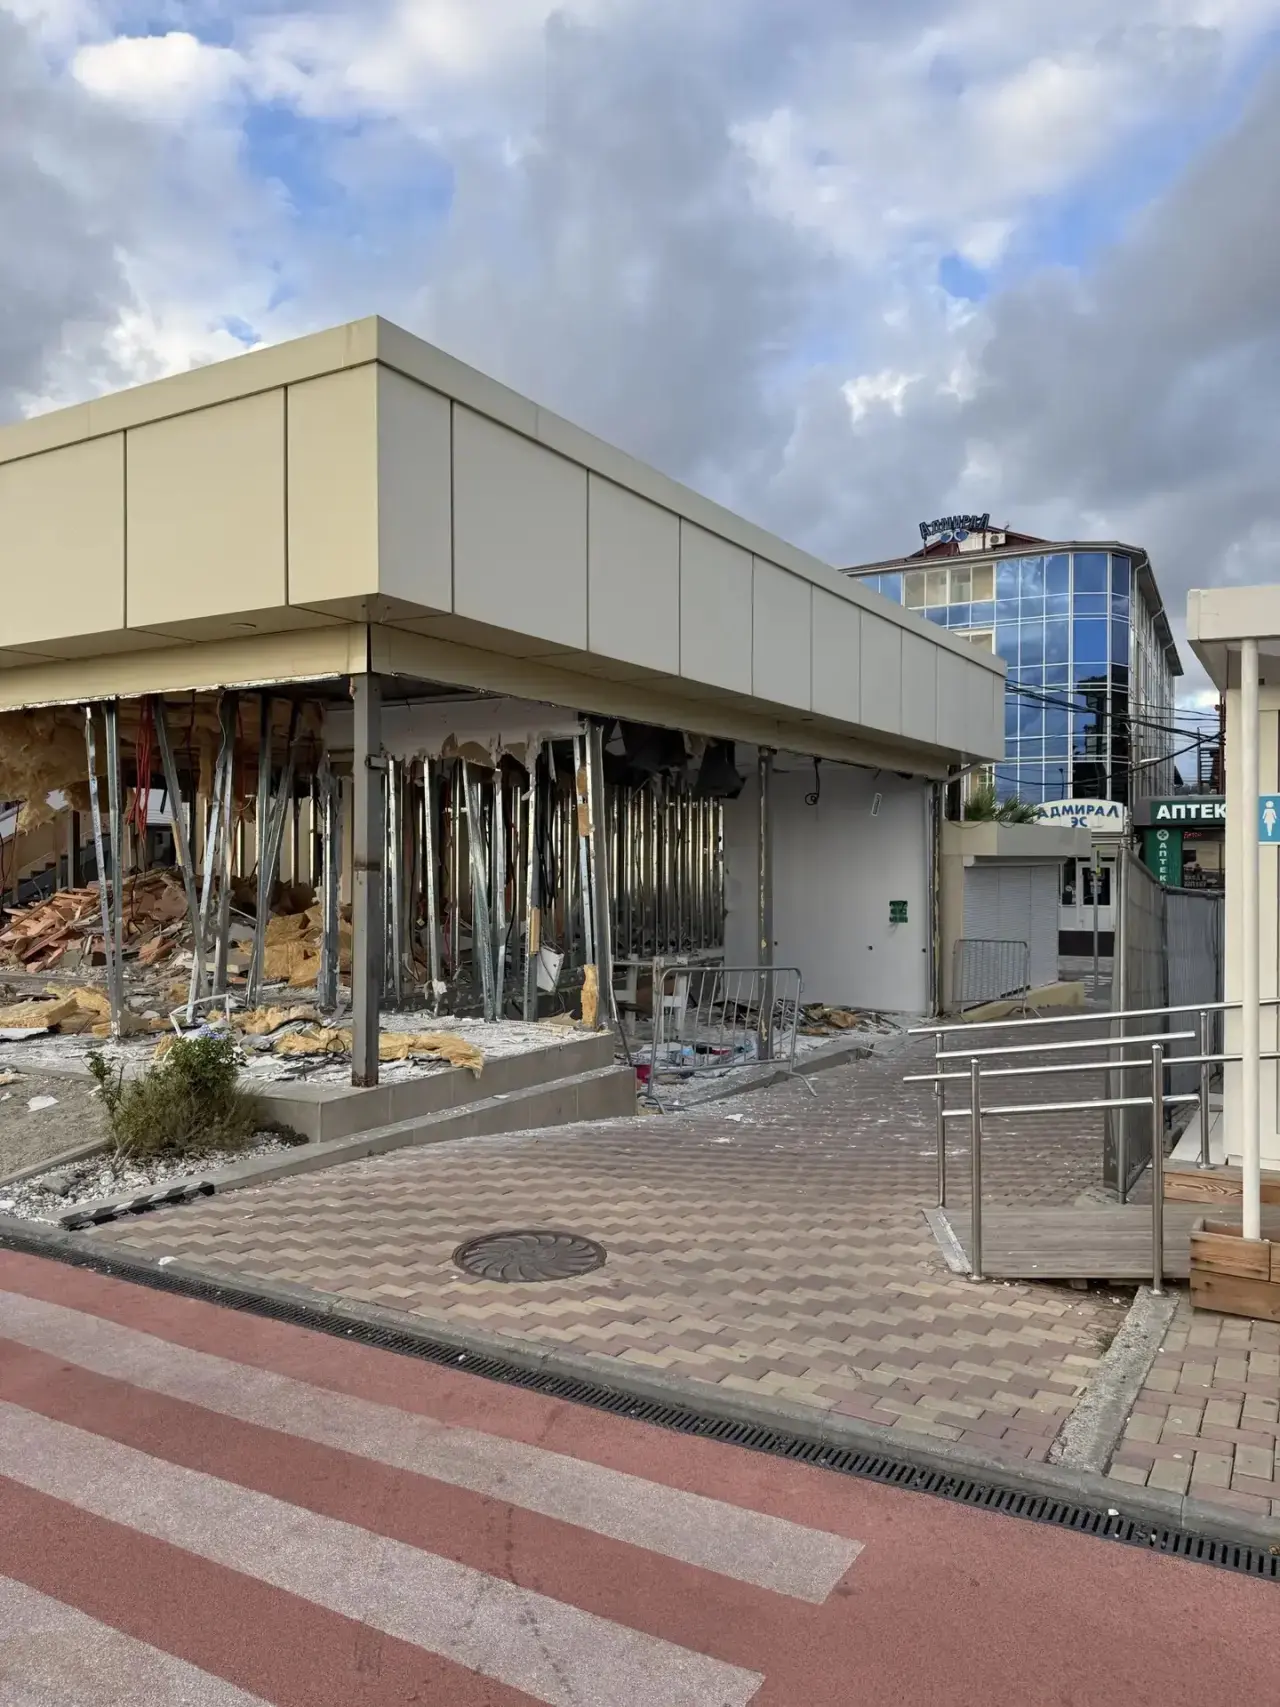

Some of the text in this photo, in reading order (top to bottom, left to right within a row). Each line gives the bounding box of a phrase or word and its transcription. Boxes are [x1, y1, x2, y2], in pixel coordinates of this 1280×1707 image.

[919, 513, 990, 540] АДМИРАЛ
[1036, 804, 1119, 819] АДМИРАЛ
[1156, 803, 1226, 820] АПТЕК
[1070, 816, 1088, 828] ЭС
[1159, 842, 1167, 884] АПТЕК
